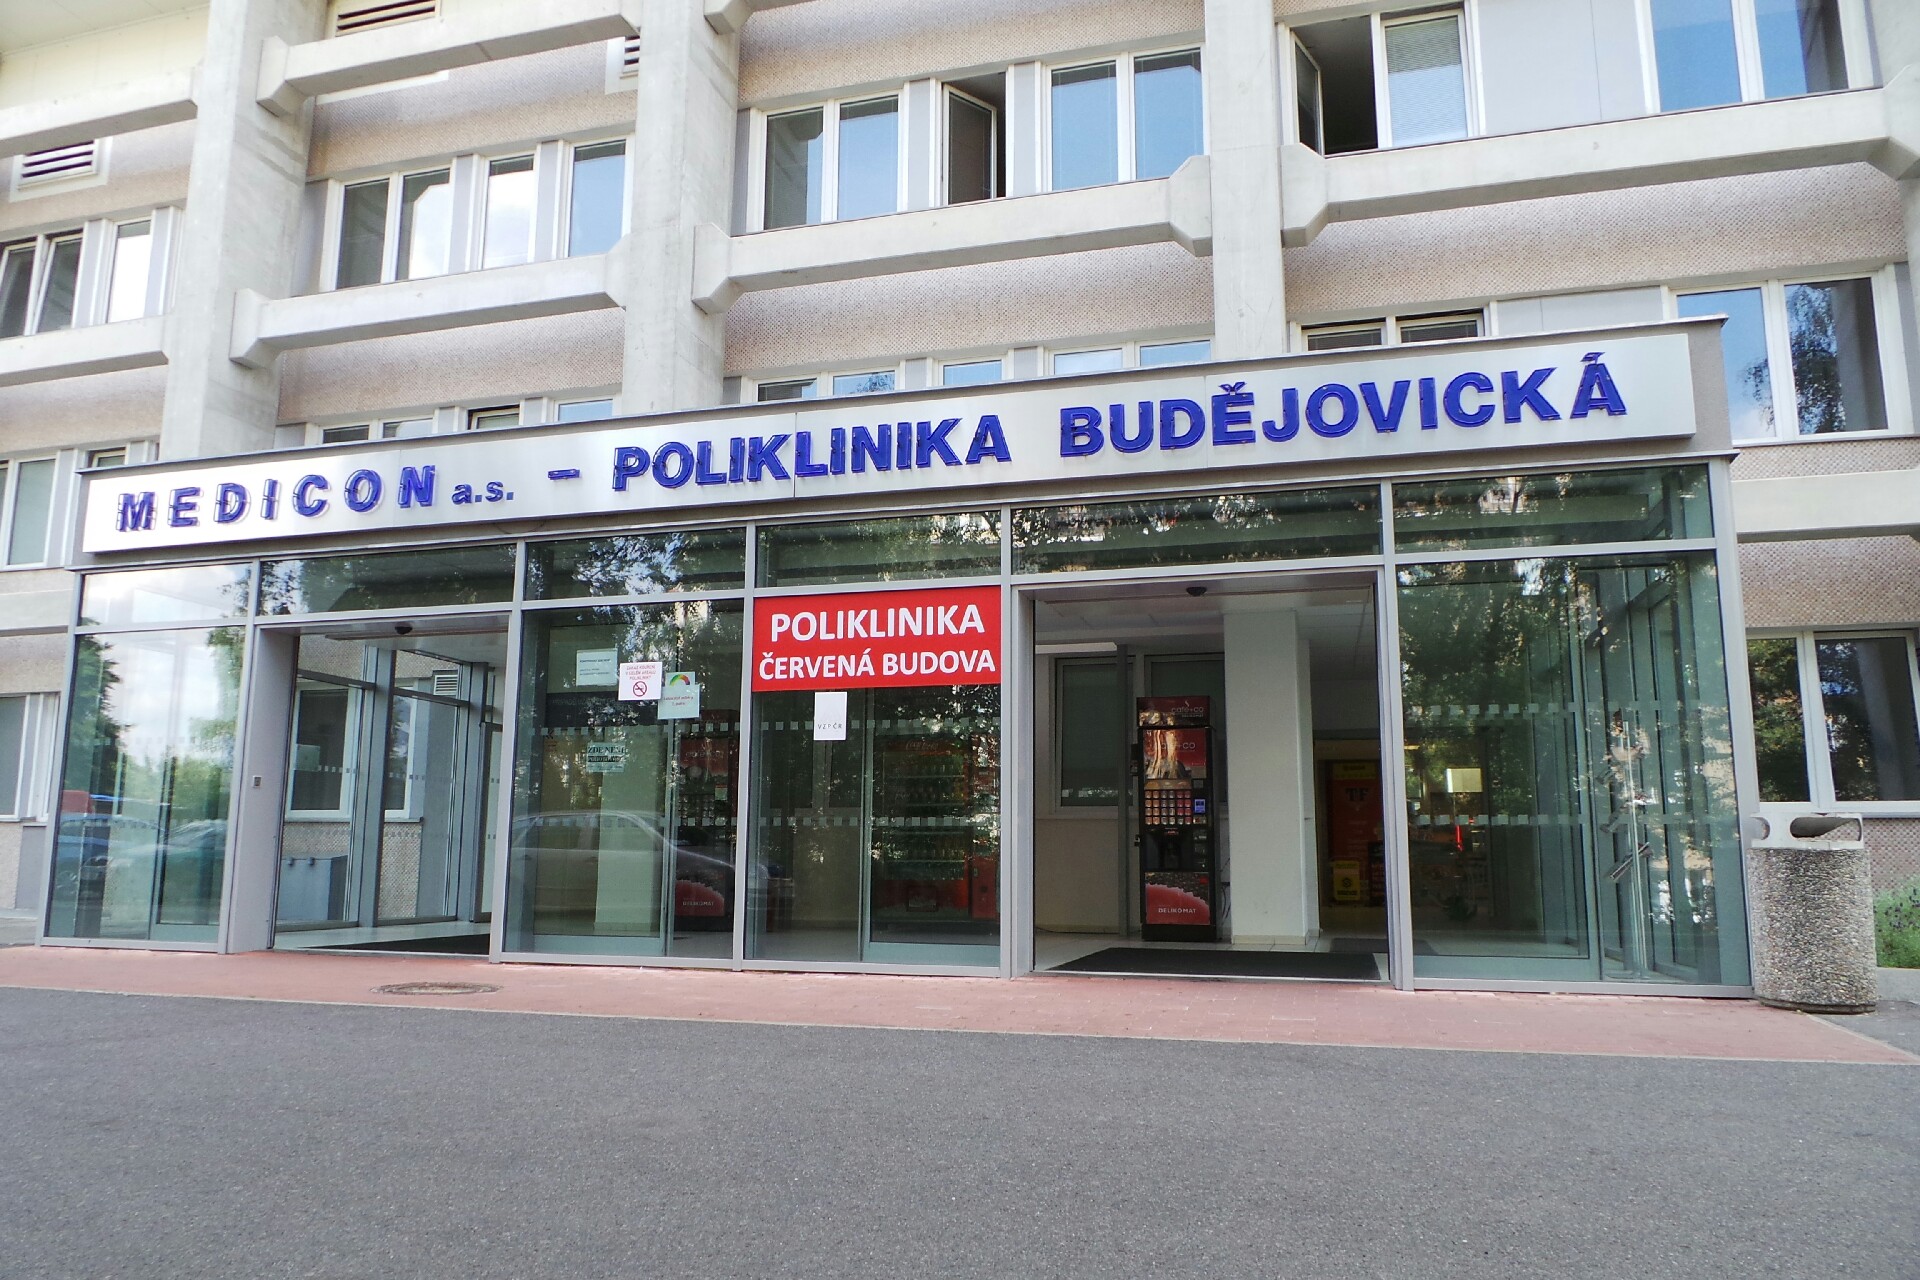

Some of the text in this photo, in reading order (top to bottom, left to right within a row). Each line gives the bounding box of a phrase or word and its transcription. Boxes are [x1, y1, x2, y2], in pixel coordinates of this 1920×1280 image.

[119, 464, 436, 531] MEDICON
[451, 482, 516, 507] a.s.
[612, 414, 1012, 492] POLIKLINIKA
[1059, 351, 1628, 458] BUDĚJOVICKÁ
[769, 603, 987, 643] POLIKLINIKA
[757, 646, 997, 681] ČERVENÁ BUDOVA
